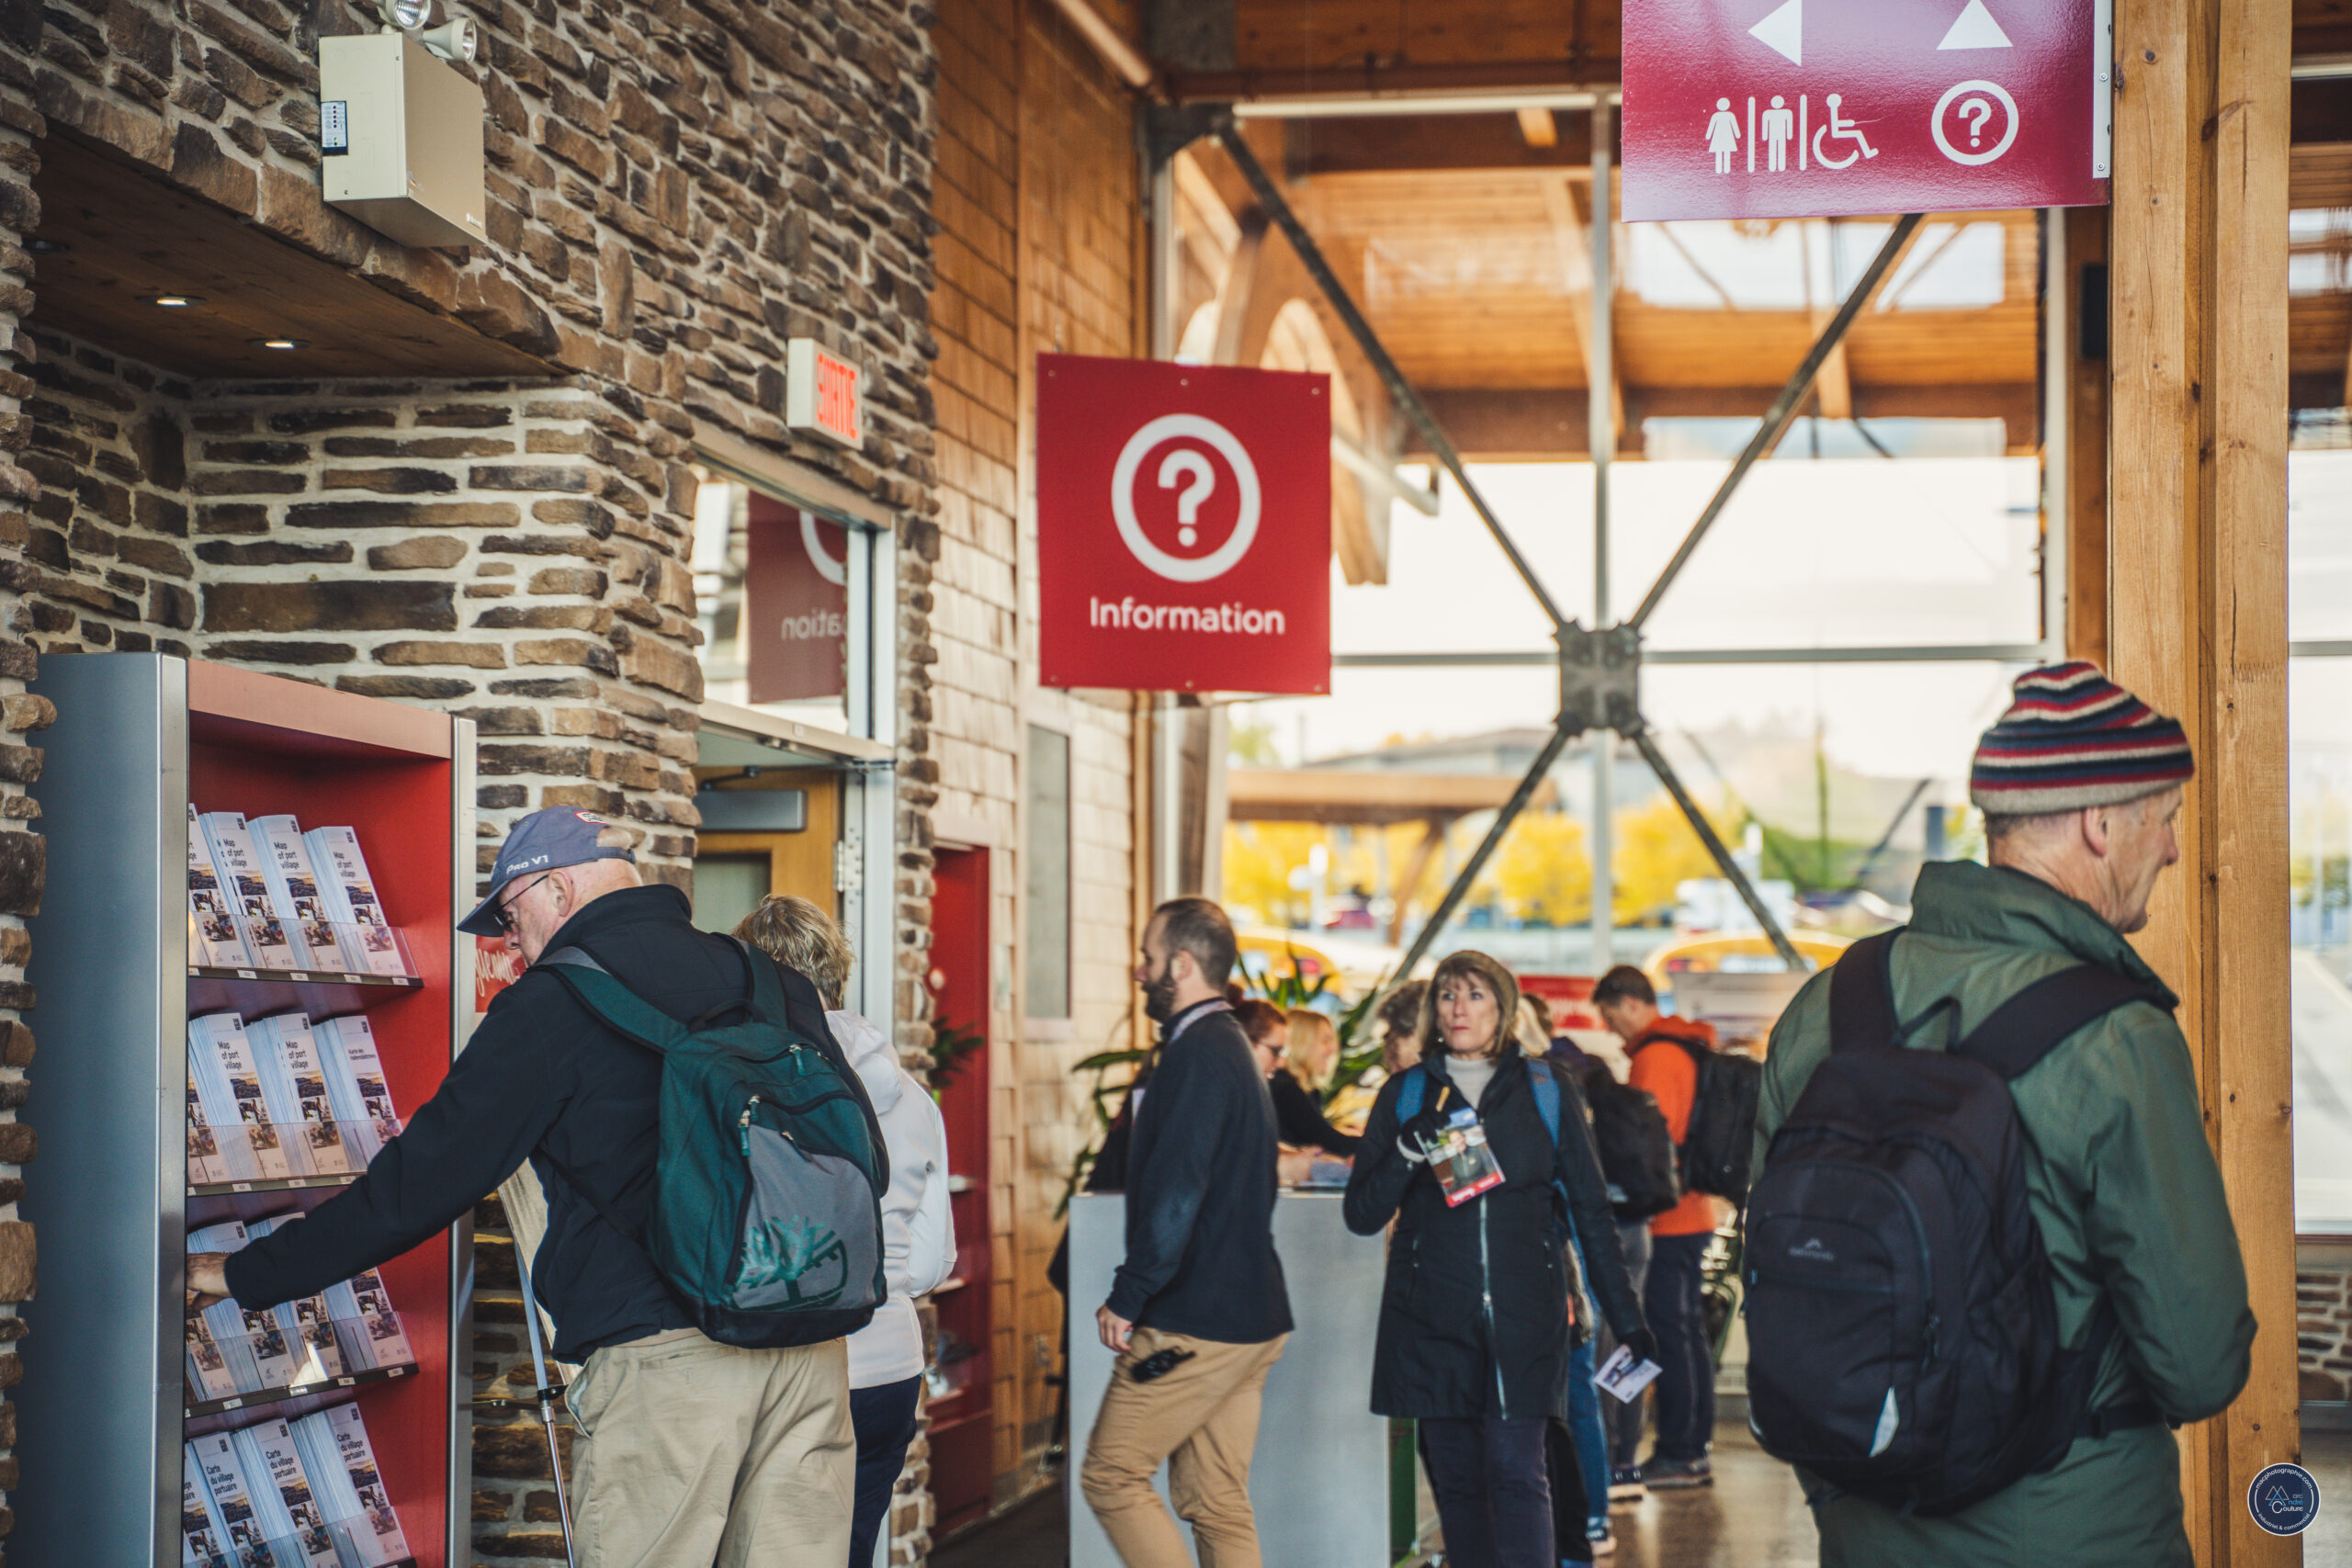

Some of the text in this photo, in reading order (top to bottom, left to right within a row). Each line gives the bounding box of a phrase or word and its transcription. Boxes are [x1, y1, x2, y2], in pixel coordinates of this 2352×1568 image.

[1090, 595, 1285, 635] Information
[223, 839, 236, 847] Map
[273, 841, 288, 850] Map
[227, 849, 244, 857] of port
[277, 851, 297, 860] of port
[231, 858, 247, 867] village
[531, 854, 549, 864] V1
[280, 861, 300, 870] village
[217, 1041, 231, 1049] Map
[285, 1041, 299, 1049] Map
[221, 1051, 240, 1059] of port
[288, 1050, 307, 1059] of port
[224, 1061, 243, 1070] village
[290, 1060, 309, 1069] village
[336, 1433, 351, 1442] Carte
[340, 1439, 363, 1452] du village
[266, 1450, 281, 1460] Carte
[344, 1449, 366, 1462] portuaire
[270, 1457, 294, 1469] du village
[206, 1465, 220, 1475] Carte
[274, 1466, 297, 1481] portuaire
[210, 1472, 234, 1484] du village
[214, 1482, 237, 1496] portuaire
